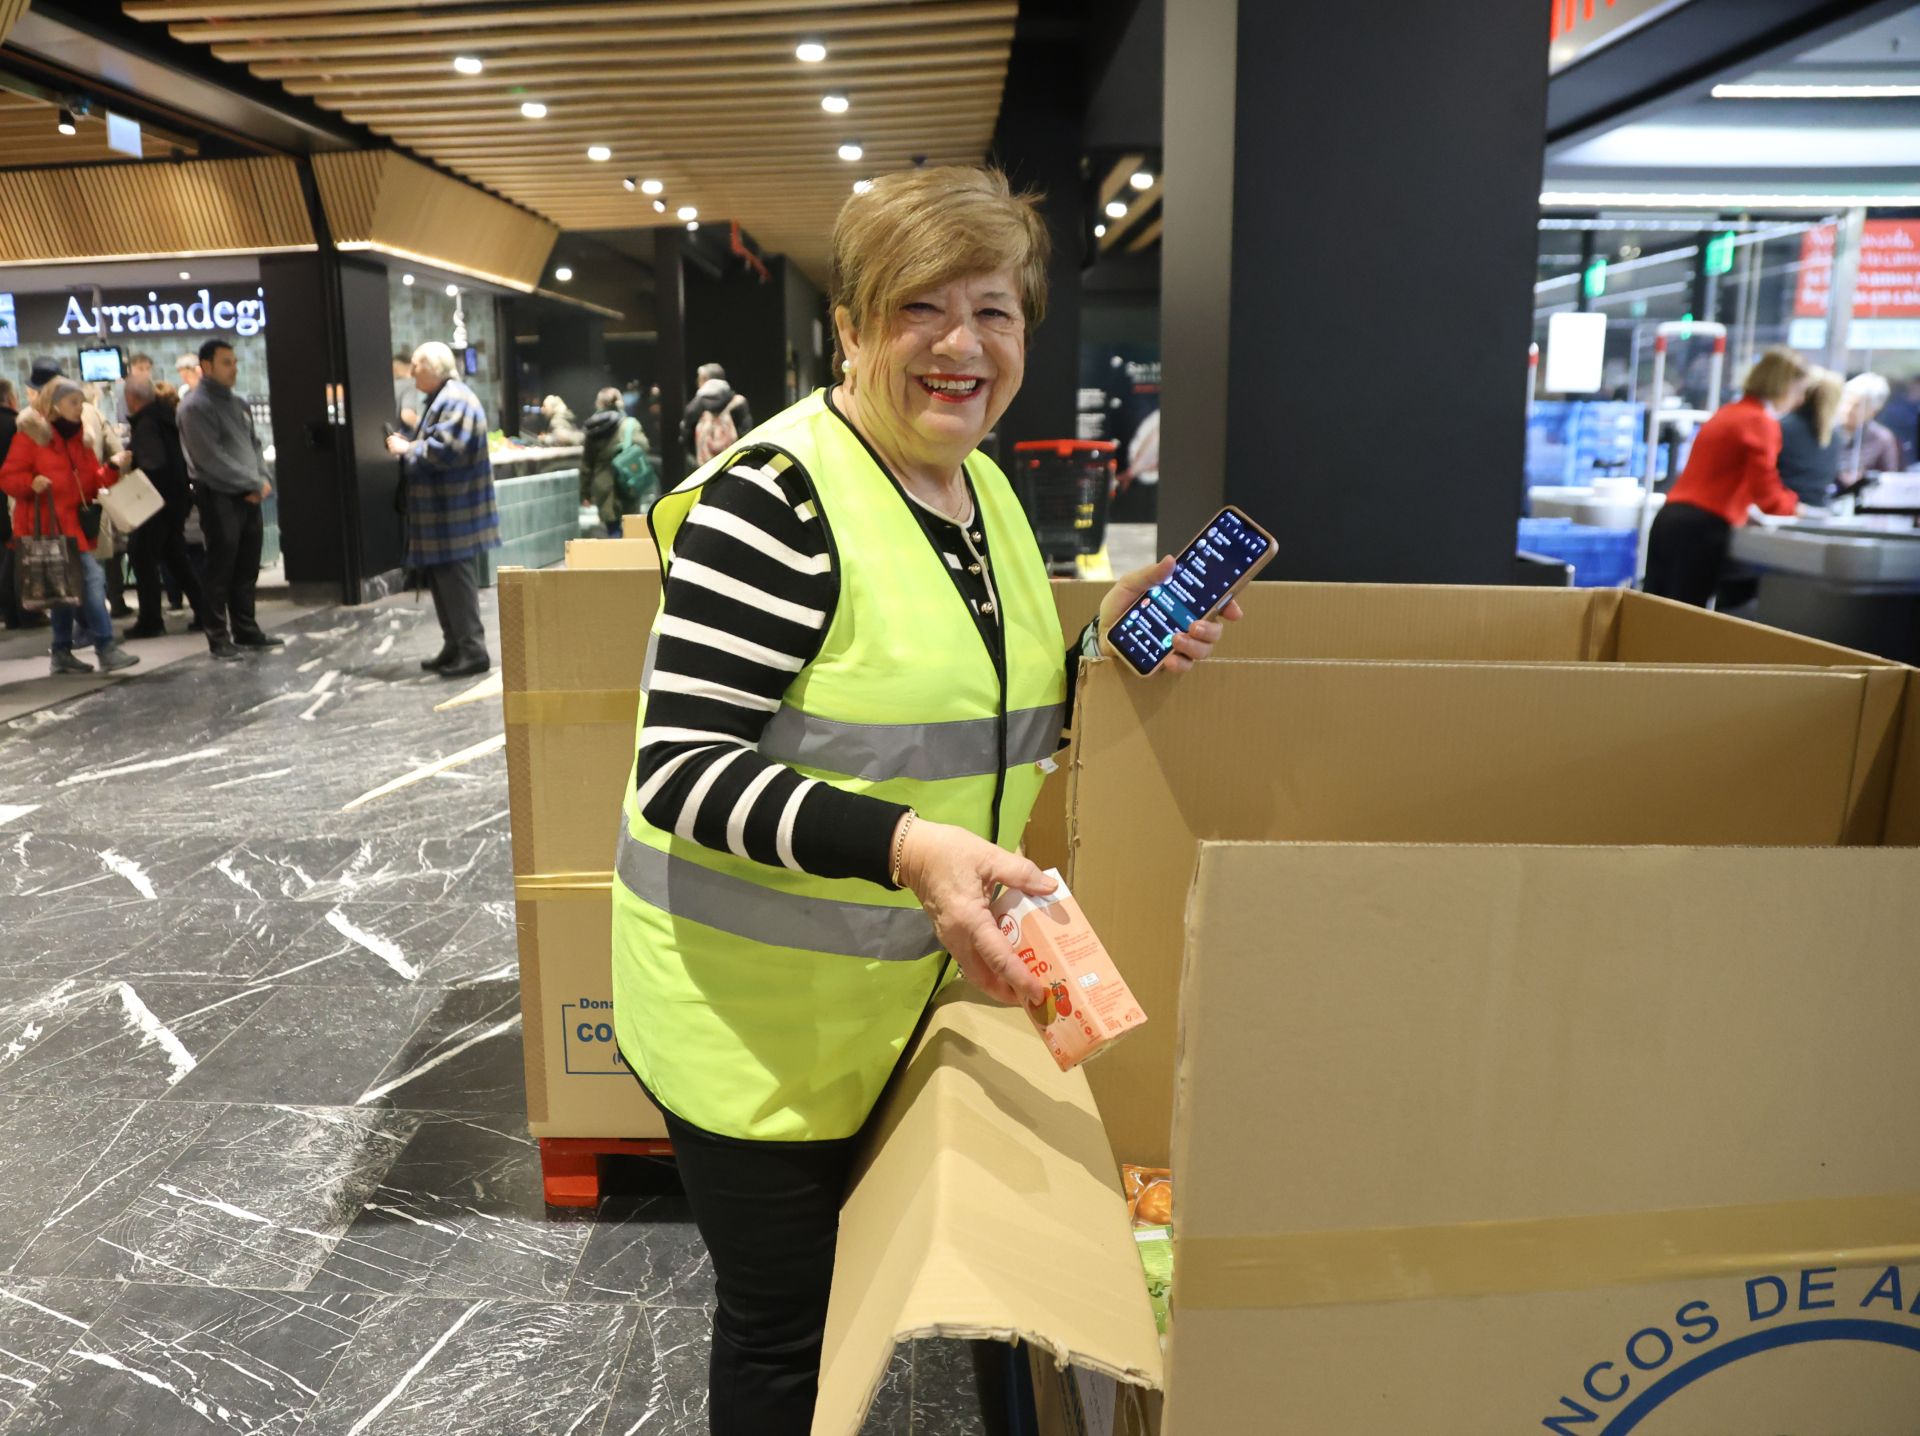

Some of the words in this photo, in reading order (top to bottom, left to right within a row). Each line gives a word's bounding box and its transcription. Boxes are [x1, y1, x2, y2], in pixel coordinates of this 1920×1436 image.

[58, 287, 266, 336] Arraindegi
[1745, 1267, 1837, 1321] DE
[1859, 1266, 1920, 1316] A
